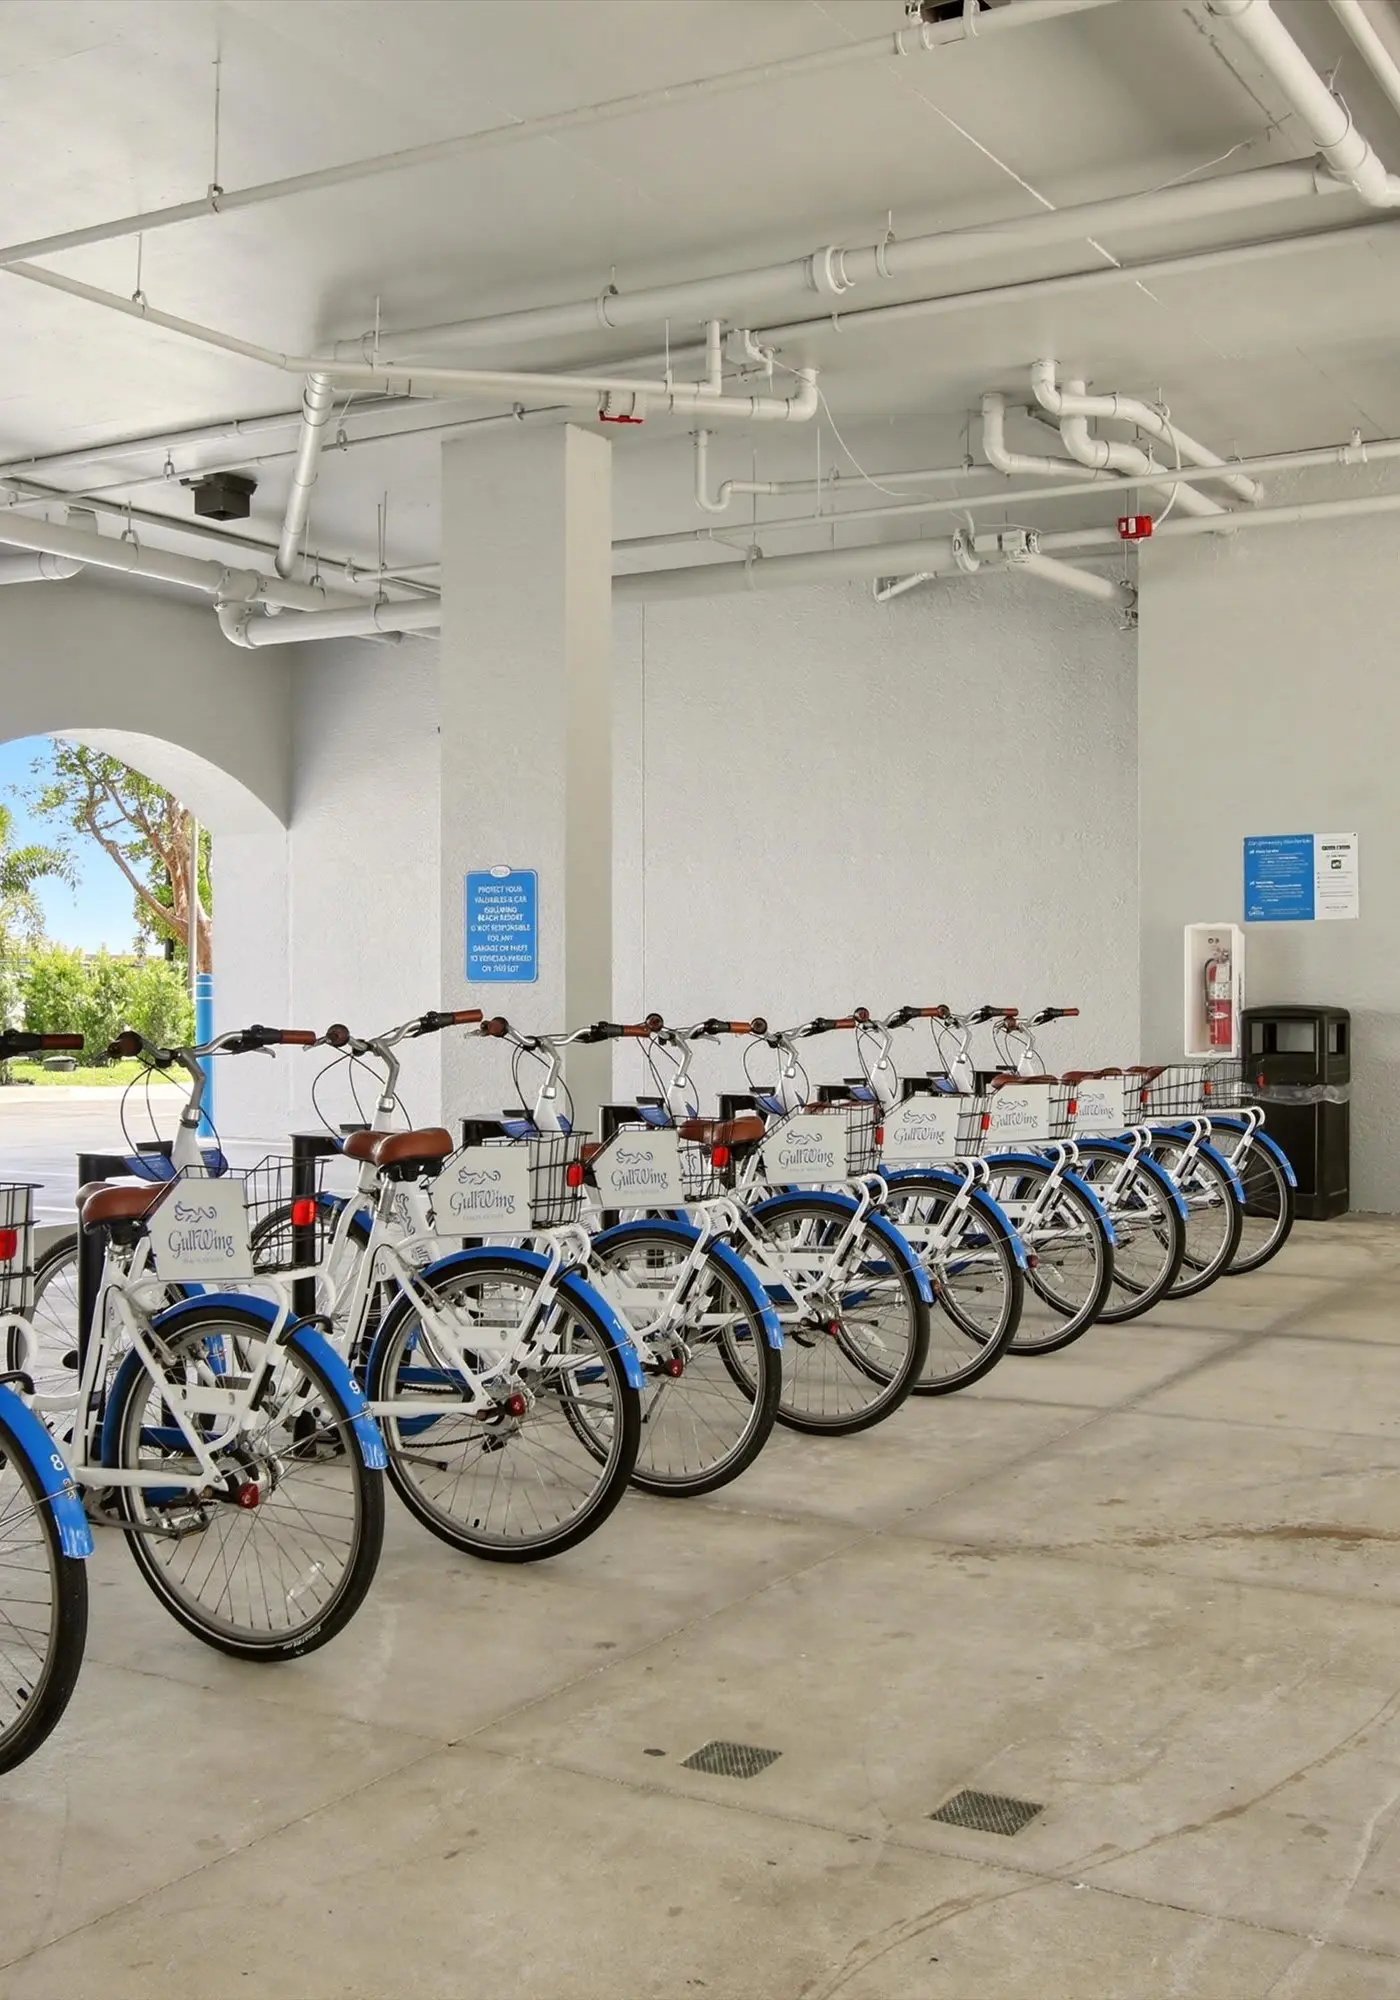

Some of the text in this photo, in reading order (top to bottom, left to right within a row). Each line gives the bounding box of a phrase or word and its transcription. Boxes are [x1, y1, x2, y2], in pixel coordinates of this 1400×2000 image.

[991, 1111, 1038, 1130] GullWing
[893, 1126, 946, 1145] GullWing
[778, 1149, 834, 1168] GullWing
[610, 1168, 669, 1191] GullWing
[449, 1187, 516, 1217] GullWing
[168, 1228, 235, 1258] GullWing
[349, 1380, 361, 1395] 9
[50, 1453, 65, 1472] 8
